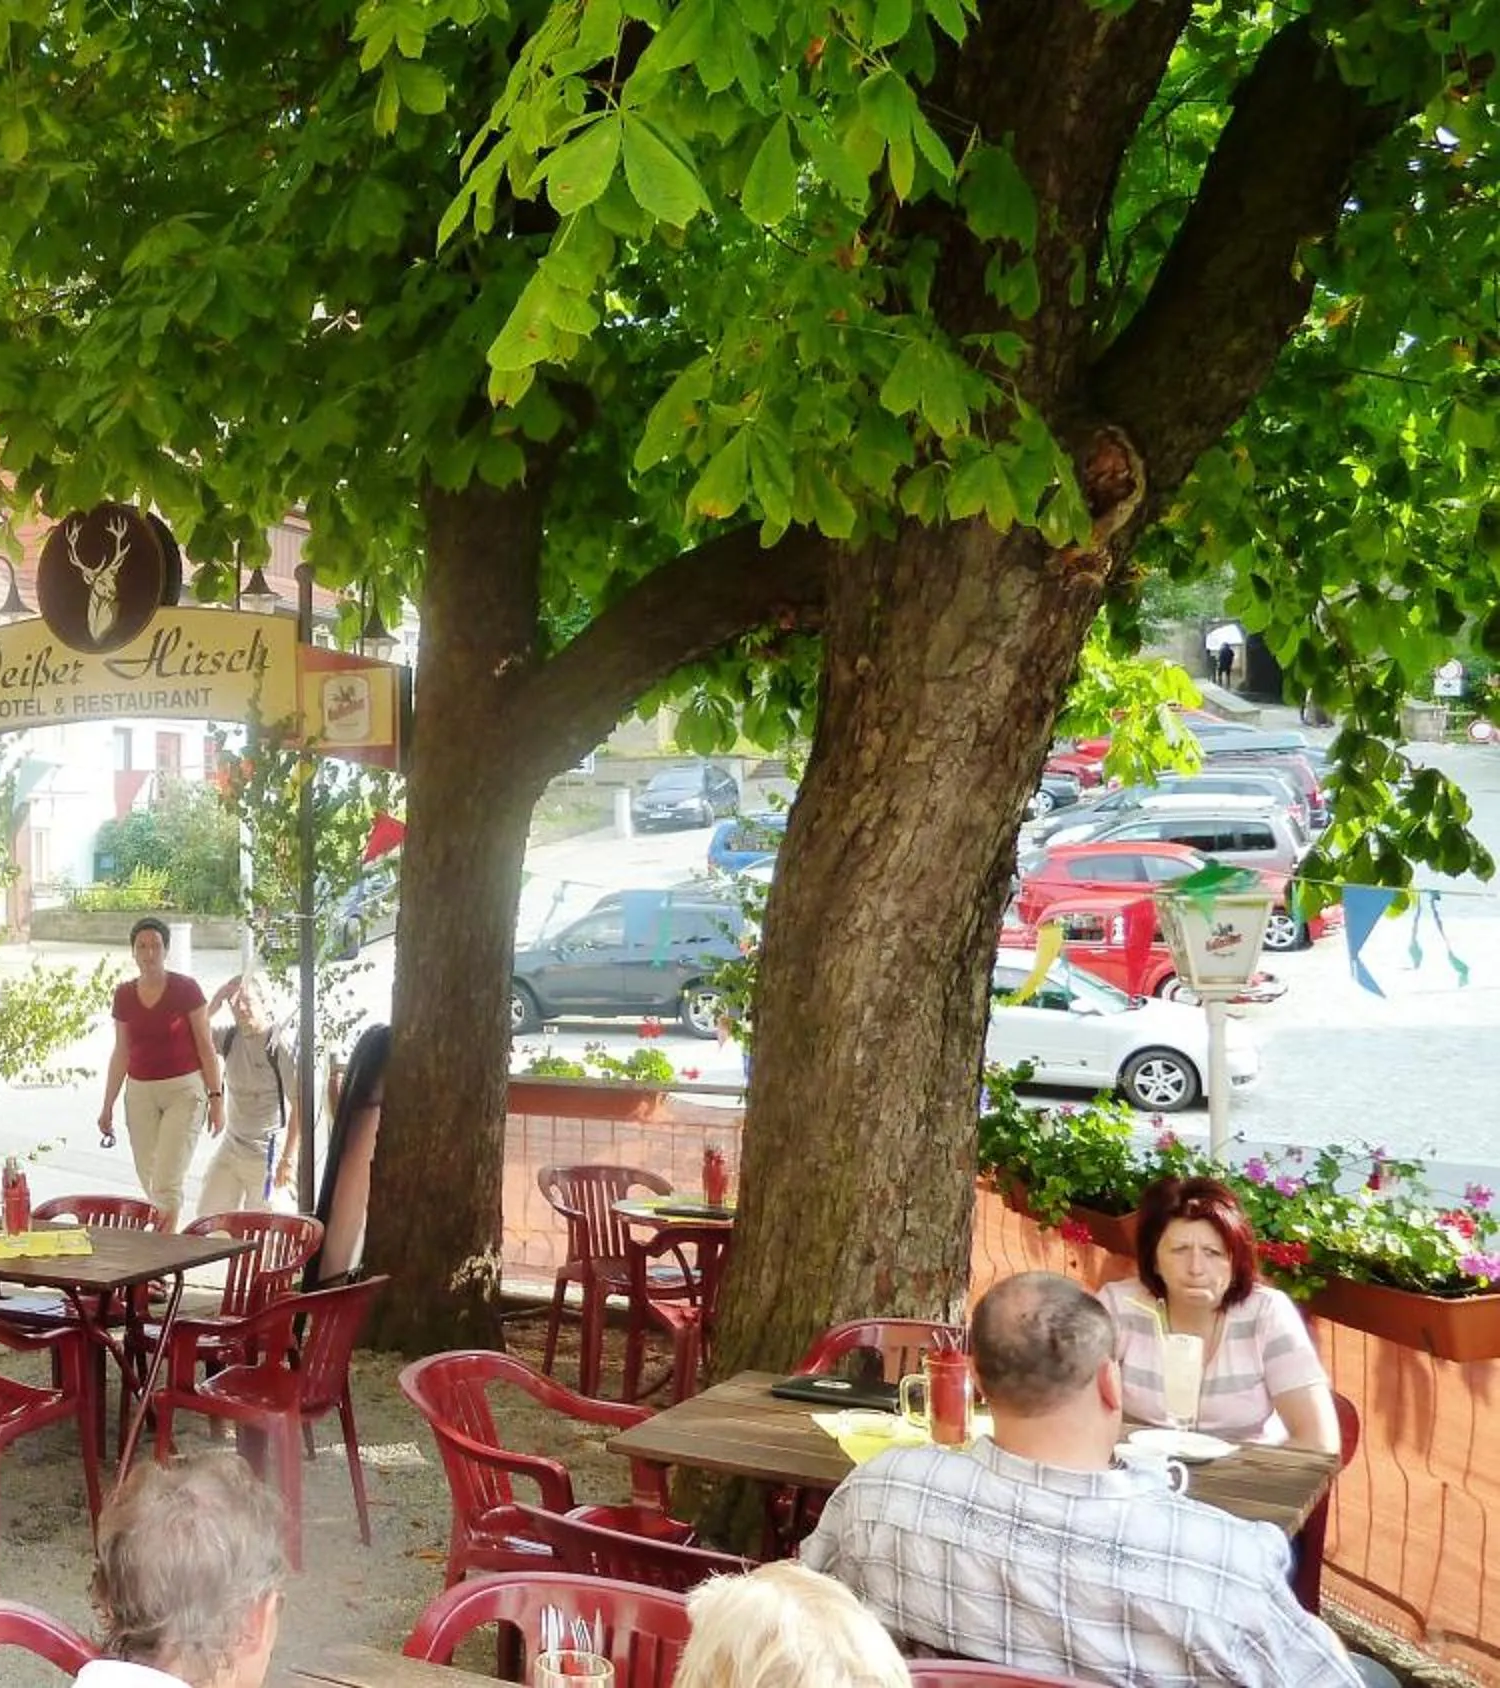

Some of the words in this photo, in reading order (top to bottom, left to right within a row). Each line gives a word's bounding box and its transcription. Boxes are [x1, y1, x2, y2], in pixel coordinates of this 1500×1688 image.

[103, 626, 271, 680] Hirsch
[53, 697, 66, 716] &
[73, 687, 213, 714] RESTAURANT
